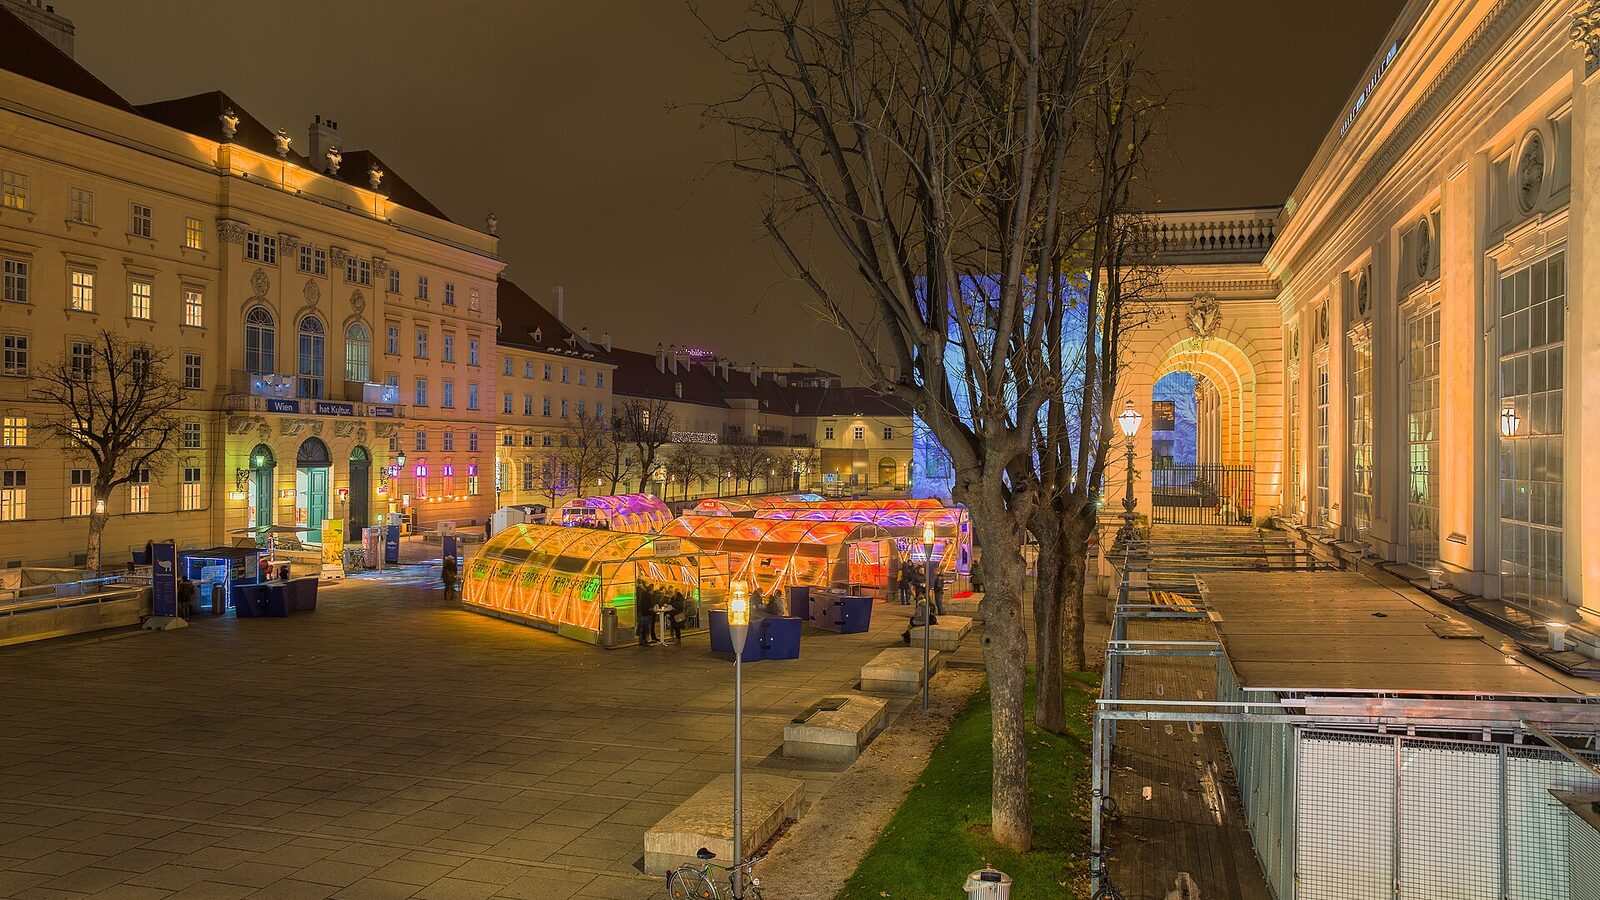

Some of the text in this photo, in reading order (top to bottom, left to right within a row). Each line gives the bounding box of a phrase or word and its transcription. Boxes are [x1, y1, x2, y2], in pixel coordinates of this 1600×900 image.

[274, 402, 293, 411] Wien
[319, 404, 351, 415] hat Kultur.
